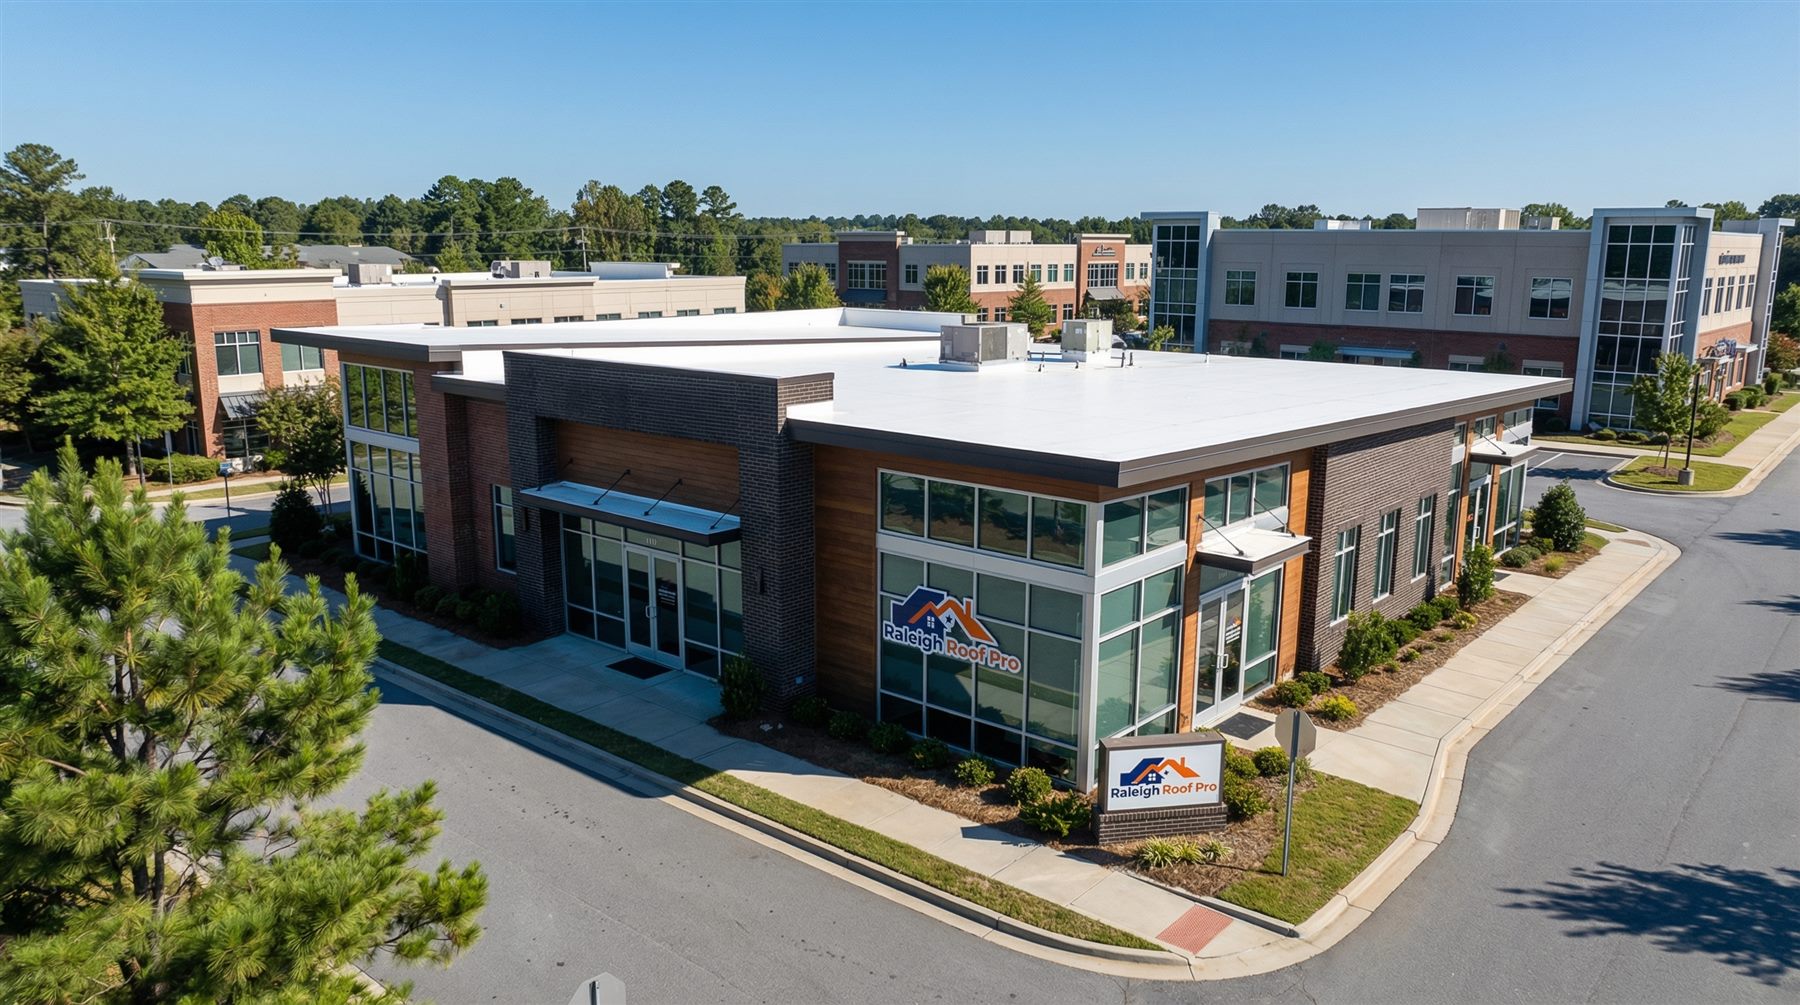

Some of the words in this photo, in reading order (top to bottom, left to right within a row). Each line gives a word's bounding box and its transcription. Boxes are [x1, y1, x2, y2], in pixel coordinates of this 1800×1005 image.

[884, 623, 943, 652] Raleigh
[946, 640, 986, 662] Roof
[989, 650, 1019, 671] Pro
[1111, 785, 1160, 799] Raleigh
[1162, 782, 1193, 795] Roof
[1195, 782, 1217, 793] Pro
